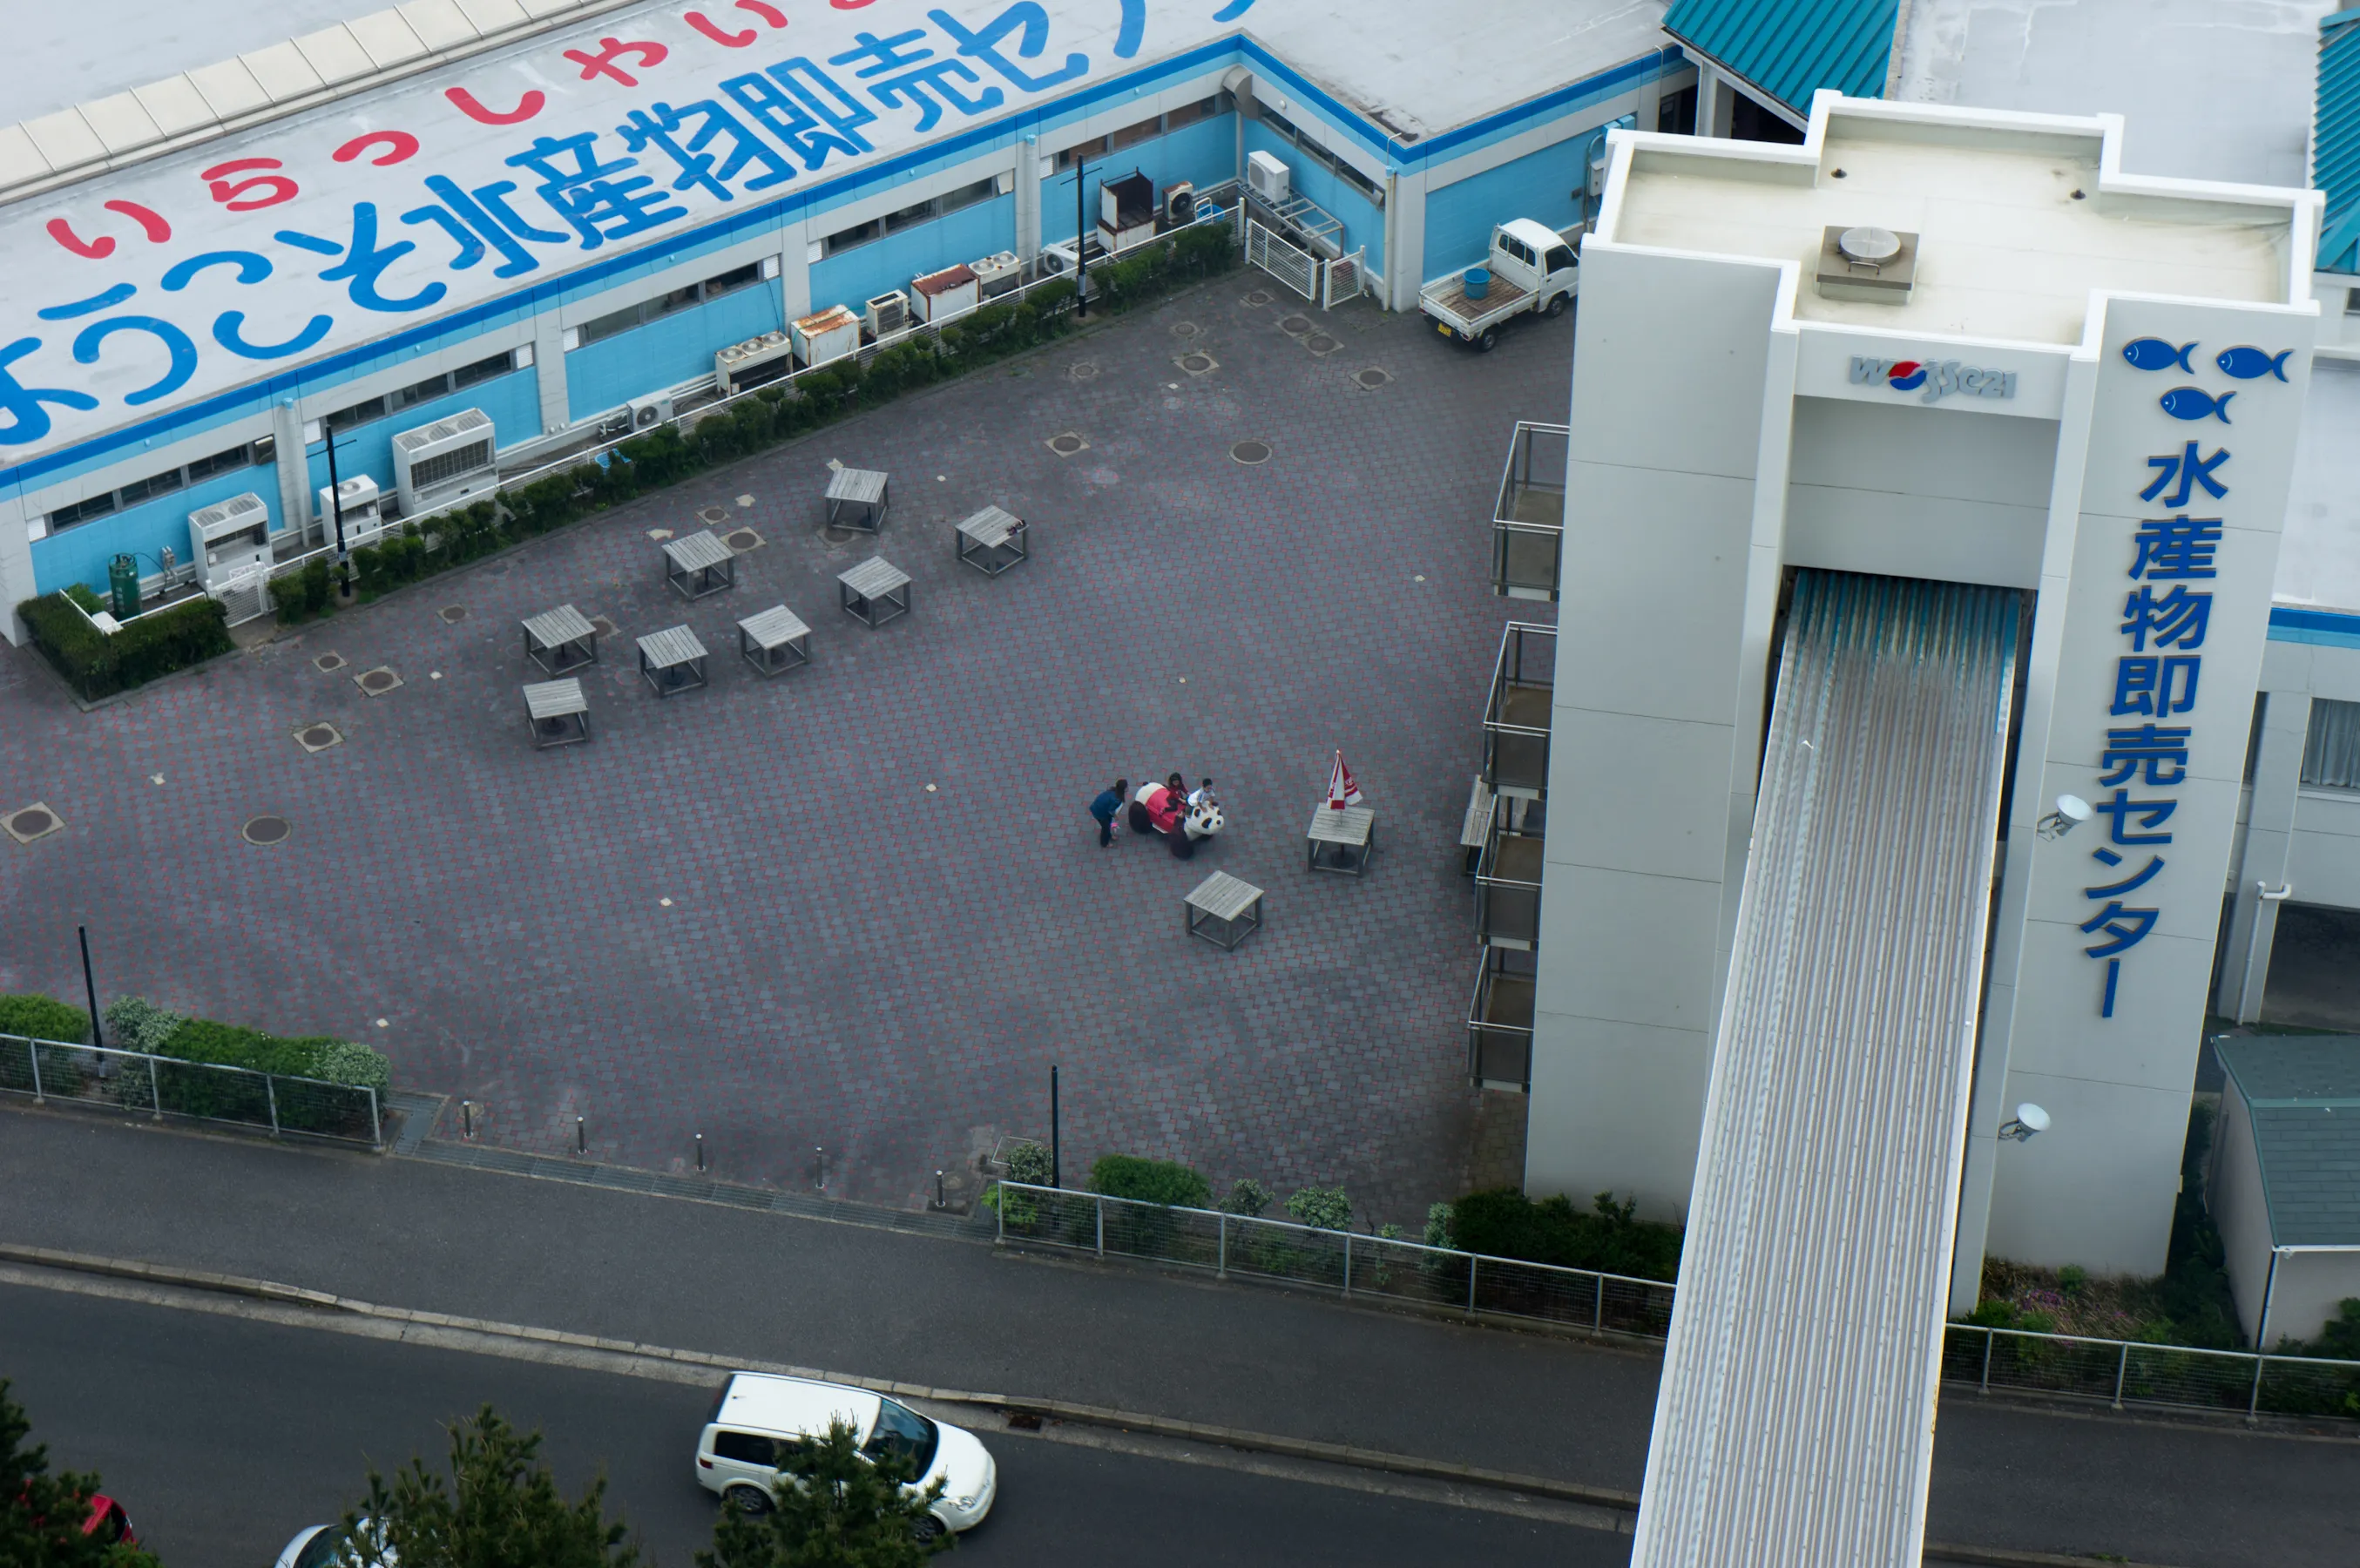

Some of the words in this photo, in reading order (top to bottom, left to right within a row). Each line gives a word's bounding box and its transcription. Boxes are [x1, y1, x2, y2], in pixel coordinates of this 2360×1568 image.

[0, 0, 1255, 446] ようこそ水産物即売セ
[46, 0, 875, 259] いらっしゃい
[2079, 440, 2232, 1017] 水産物即売センター
